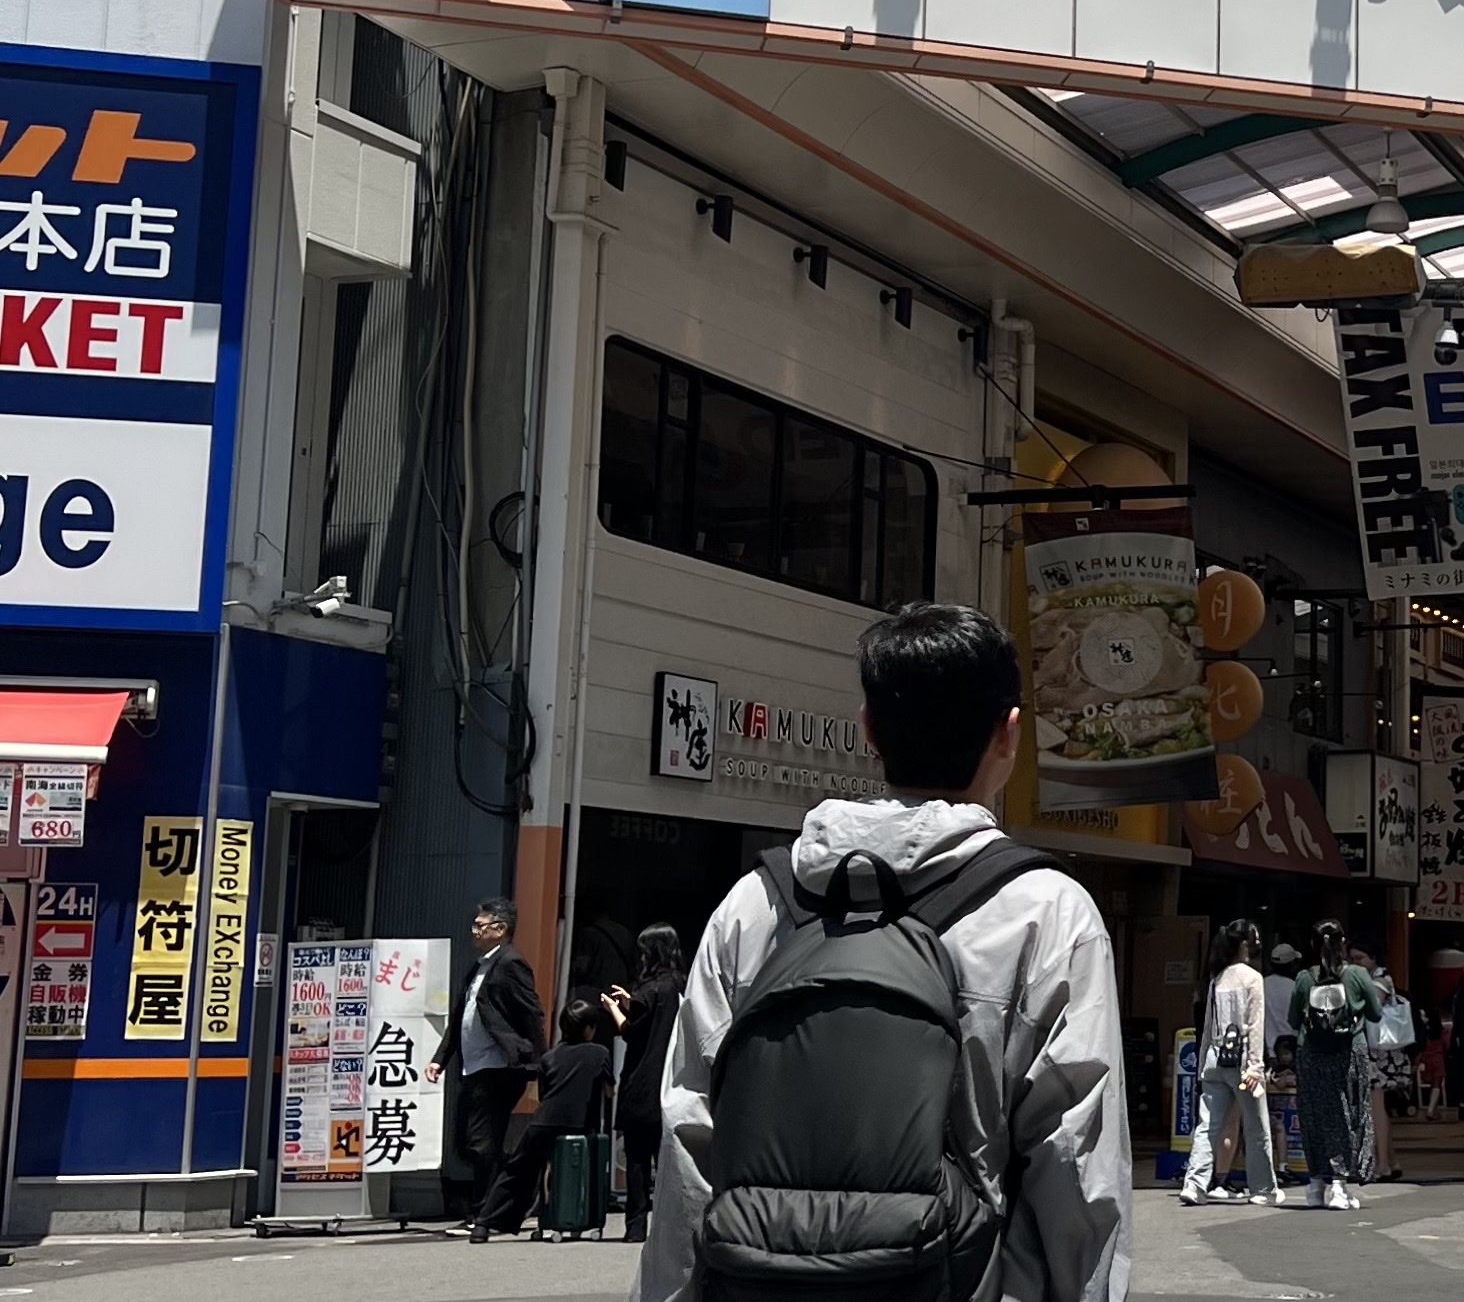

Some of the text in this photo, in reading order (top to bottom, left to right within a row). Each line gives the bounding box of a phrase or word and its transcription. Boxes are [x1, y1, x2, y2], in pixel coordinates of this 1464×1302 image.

[1075, 555, 1188, 573] KAMUKURA
[1074, 593, 1160, 608] KAMUKURA
[1081, 698, 1169, 719] OSAKA
[728, 698, 875, 757] KAMUKU
[1084, 718, 1168, 735] NAMBA
[726, 757, 770, 780] SOUP
[781, 764, 820, 787] WITH
[218, 826, 248, 905] Money
[37, 886, 94, 916] 24H
[127, 825, 200, 1028] 切符屋
[292, 969, 315, 982] 時給
[340, 962, 367, 978] 時給
[375, 958, 420, 992] まじ
[29, 984, 87, 1004] 自販機
[27, 1004, 85, 1025] 稼動中
[366, 1021, 419, 1167] 急募
